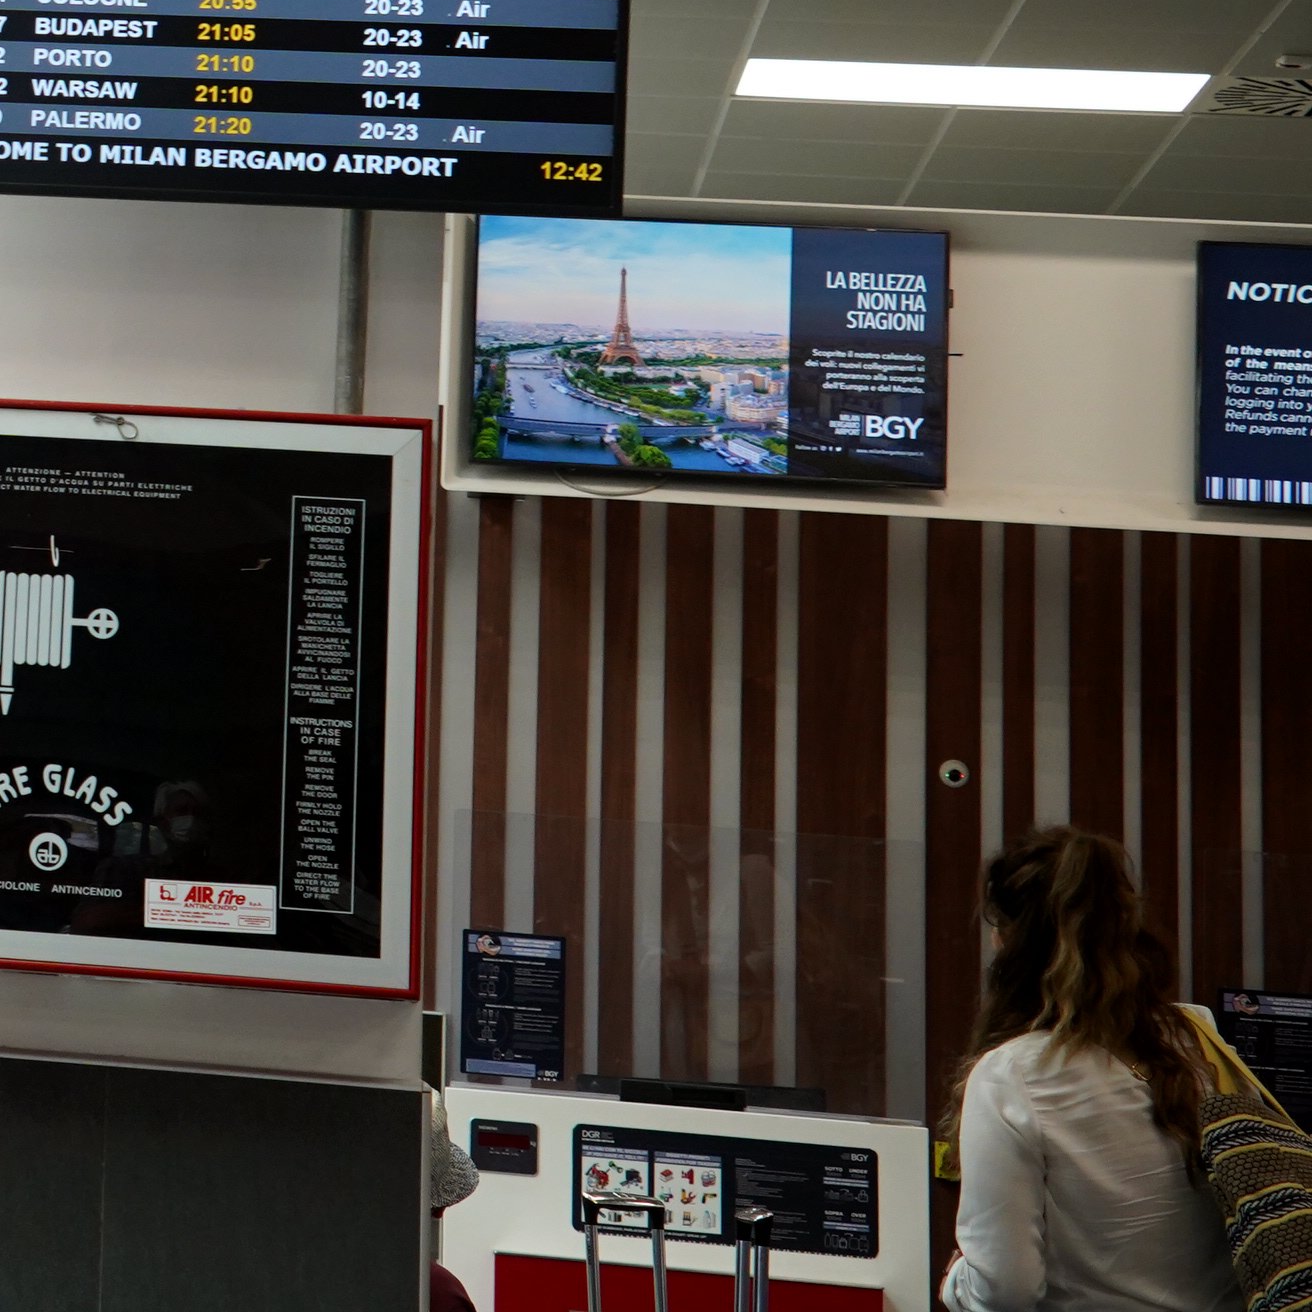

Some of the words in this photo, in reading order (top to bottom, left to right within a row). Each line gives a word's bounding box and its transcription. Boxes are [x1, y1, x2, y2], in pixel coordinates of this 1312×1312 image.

[32, 79, 137, 99] WARSAW
[195, 85, 252, 103] 21:10
[362, 91, 420, 109] 10-14
[55, 142, 92, 164] TO
[99, 144, 187, 168] MILAN
[195, 147, 327, 172] BERGAMO
[334, 153, 458, 178] AIRPORT
[541, 162, 602, 181] 12:42
[827, 271, 846, 288] LA
[849, 272, 926, 292] BELLEZZA
[1227, 281, 1312, 303] NOTIC
[858, 292, 896, 311] NON
[901, 294, 926, 312] HA
[847, 311, 924, 331] STAGIONI
[1241, 346, 1262, 356] the
[1264, 347, 1301, 358] event
[1278, 400, 1303, 410] into
[1226, 409, 1278, 422] Refunds
[866, 416, 924, 439] BGY
[302, 506, 356, 516] ISTRUZIONI
[304, 525, 352, 534] INCENDIO
[290, 717, 352, 728] INSTRUCTIONS
[314, 728, 341, 736] CASE
[301, 736, 315, 744] OF
[318, 738, 341, 746] FIRE
[43, 764, 132, 826] GLASS
[52, 884, 122, 898] ANTINCENDIO
[185, 886, 213, 904] AIR
[217, 889, 246, 906] fire
